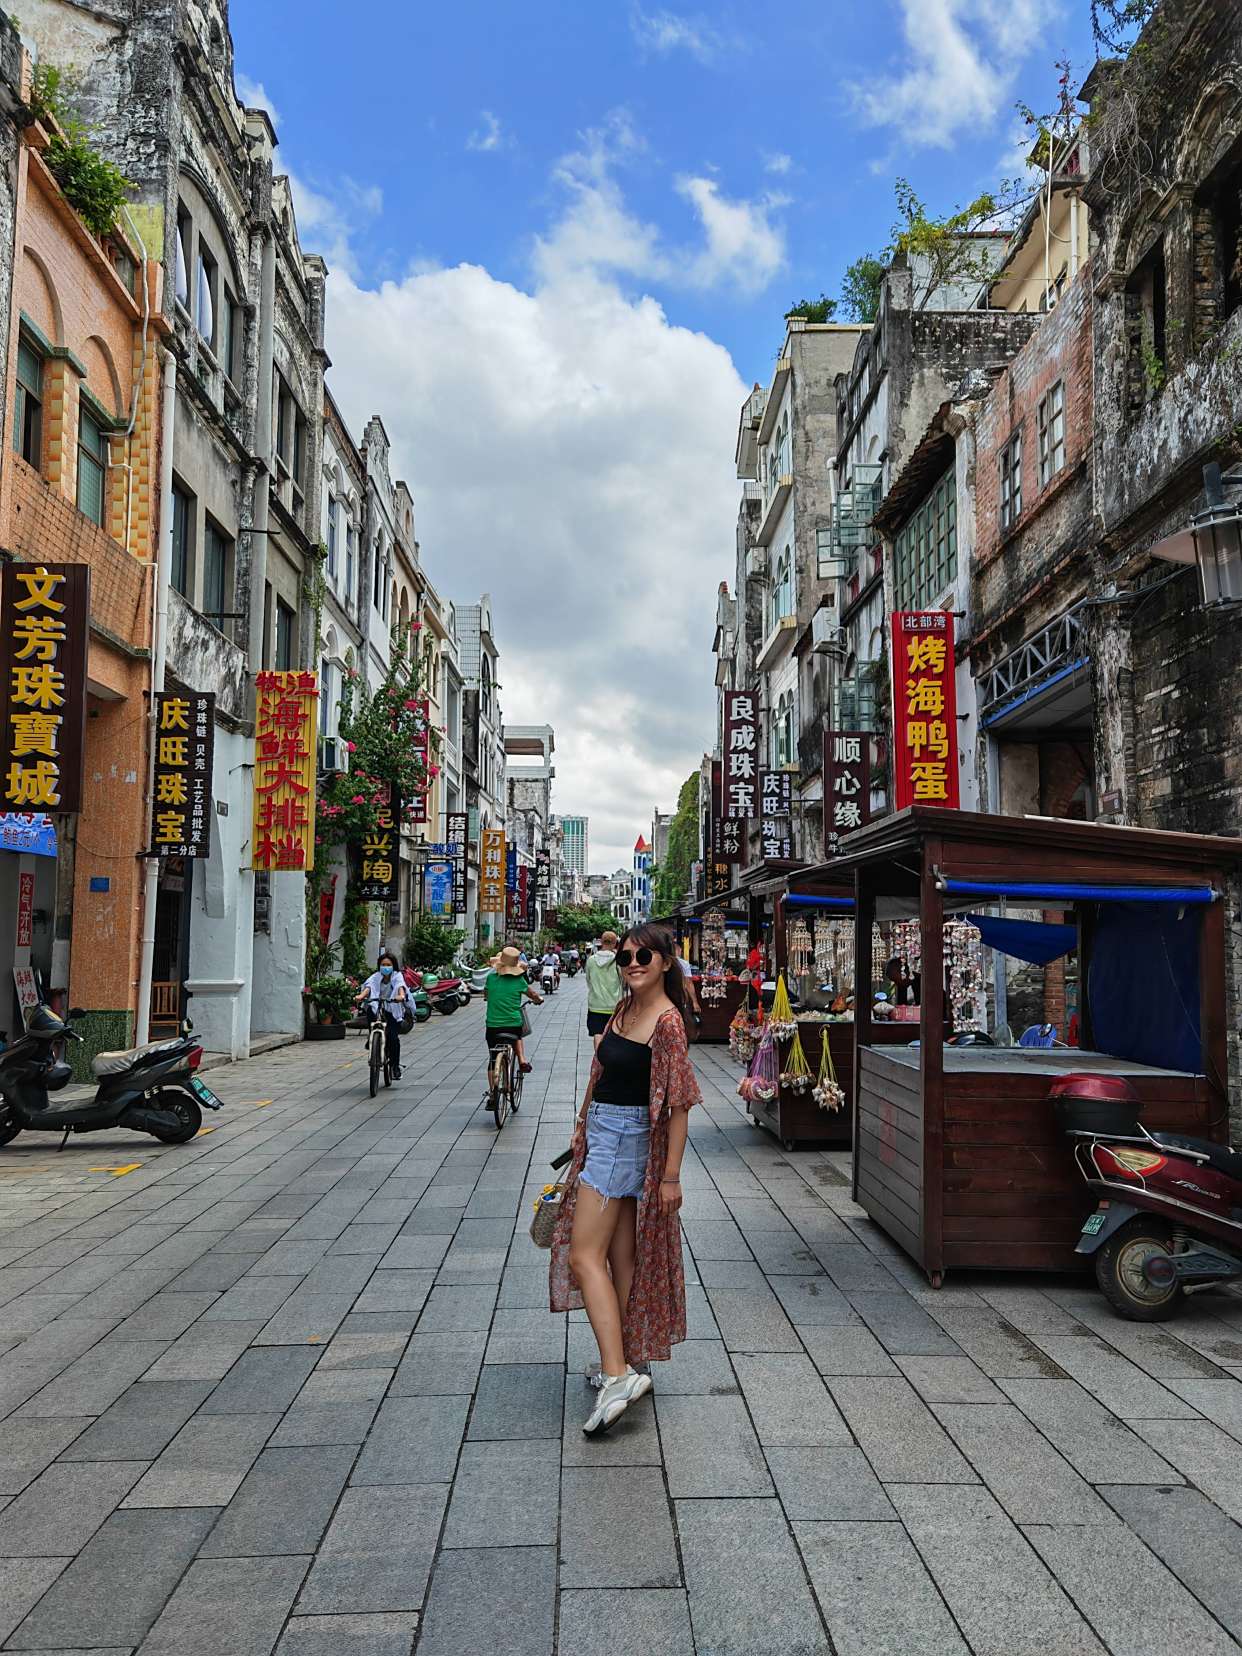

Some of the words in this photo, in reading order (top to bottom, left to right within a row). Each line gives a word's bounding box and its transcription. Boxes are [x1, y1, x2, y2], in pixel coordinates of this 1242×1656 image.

[905, 615, 946, 629] 北部湾
[5, 566, 66, 806] 文芳珠寶城
[196, 698, 208, 738] 珍珠链
[905, 635, 949, 800] 烤海鸭蛋
[156, 697, 191, 843] 庆旺珠宝
[194, 743, 206, 770] 贝壳
[255, 696, 310, 868] 海鲜大排档
[729, 695, 757, 808] 良成珠宝
[833, 736, 862, 828] 顺心缘
[190, 778, 204, 842] 工艺品批发
[723, 821, 741, 854] 鲜粉
[160, 845, 197, 856] 第二分店
[485, 832, 502, 897] 万利珠宝
[18, 874, 34, 945] 冷气开放
